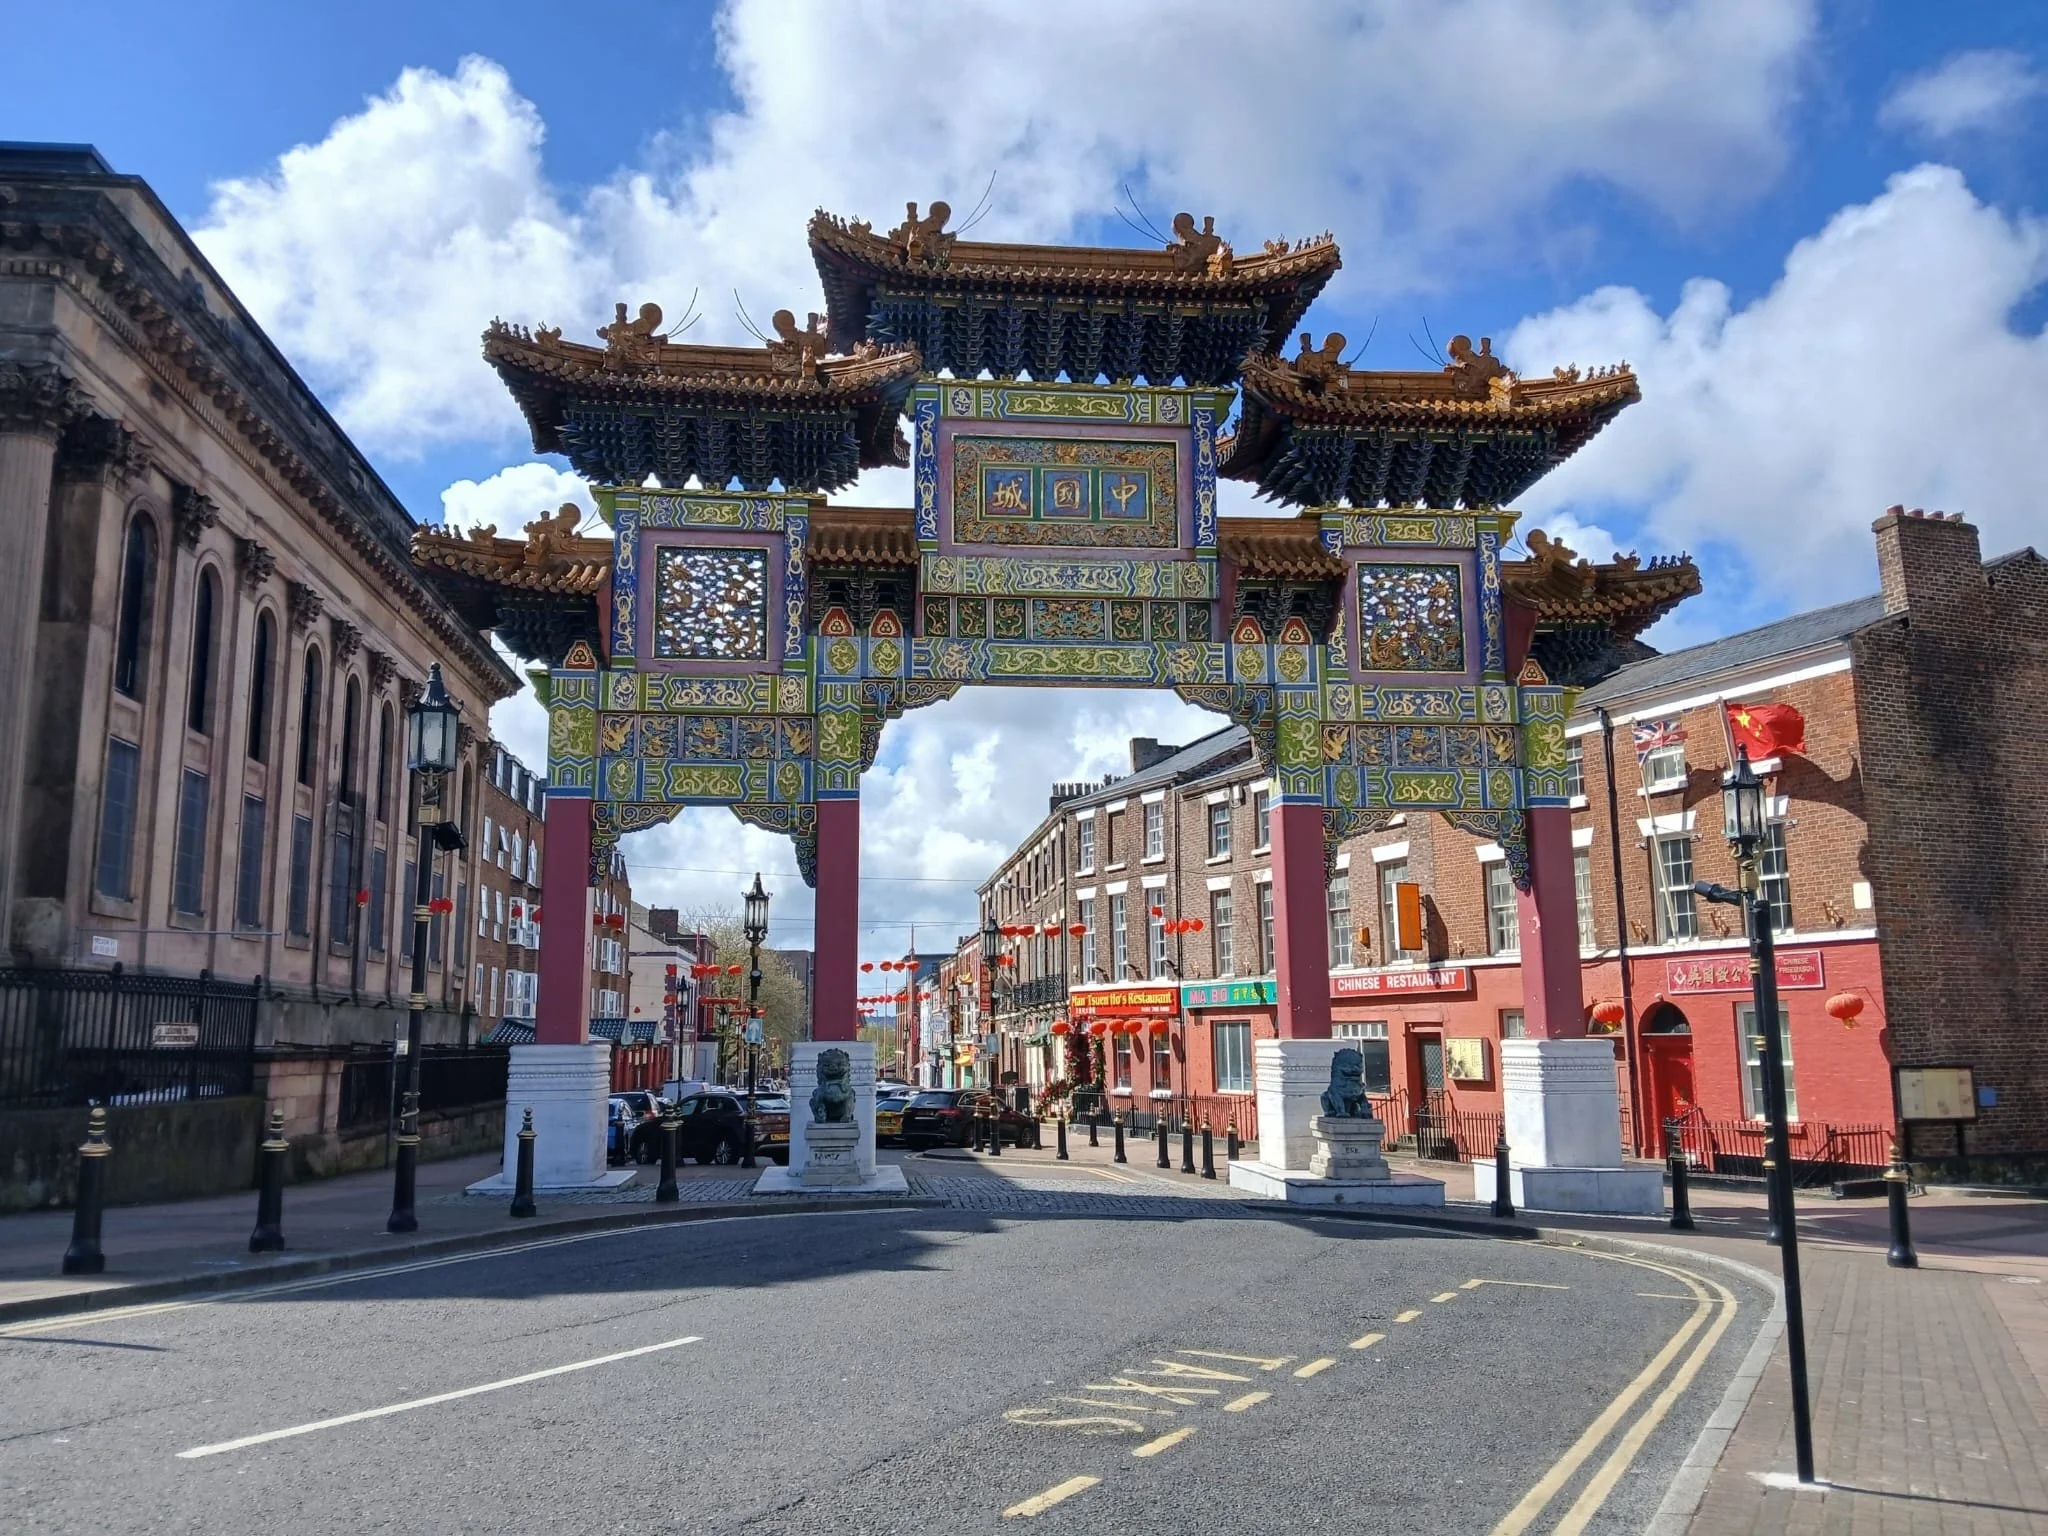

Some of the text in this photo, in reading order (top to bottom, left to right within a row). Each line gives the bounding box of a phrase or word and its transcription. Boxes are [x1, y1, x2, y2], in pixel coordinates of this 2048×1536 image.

[1783, 956, 1809, 966] CHINESE
[1337, 971, 1456, 991] CHINESE RESTAURANT
[1128, 991, 1172, 1005] Restaurant
[1189, 989, 1207, 1004] MA
[1211, 988, 1228, 1003] BO
[1001, 1349, 1298, 1436] TAXIS
